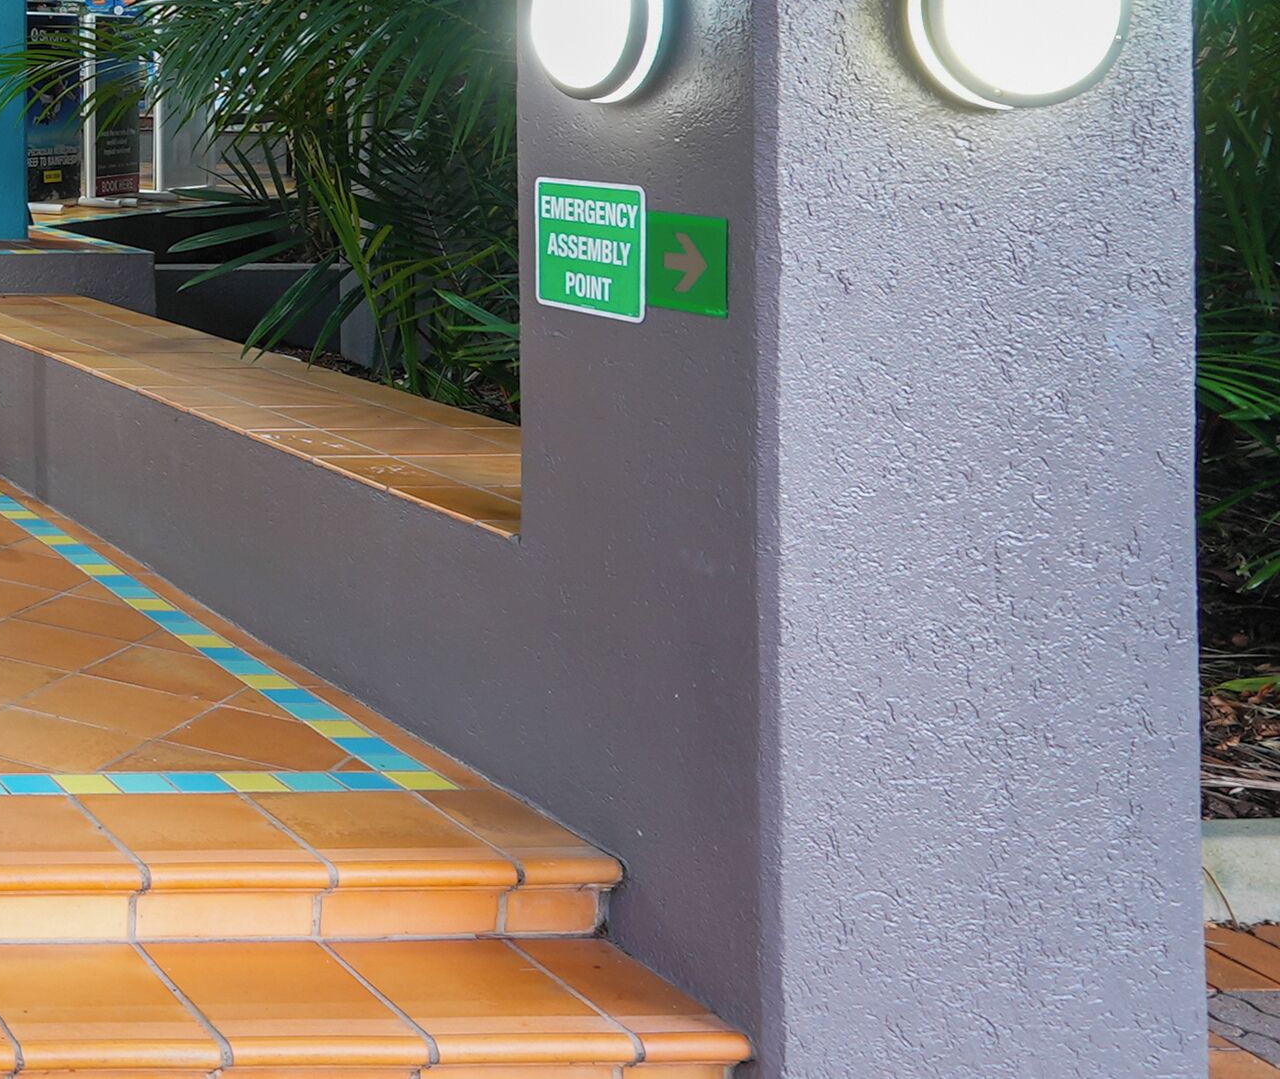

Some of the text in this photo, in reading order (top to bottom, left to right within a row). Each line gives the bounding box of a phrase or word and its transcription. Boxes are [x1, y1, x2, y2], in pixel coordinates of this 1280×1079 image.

[101, 178, 134, 193] BOOK HERE
[541, 195, 639, 229] EMERGENCY
[547, 232, 631, 267] ASSEMBLY
[565, 271, 612, 301] POINT
